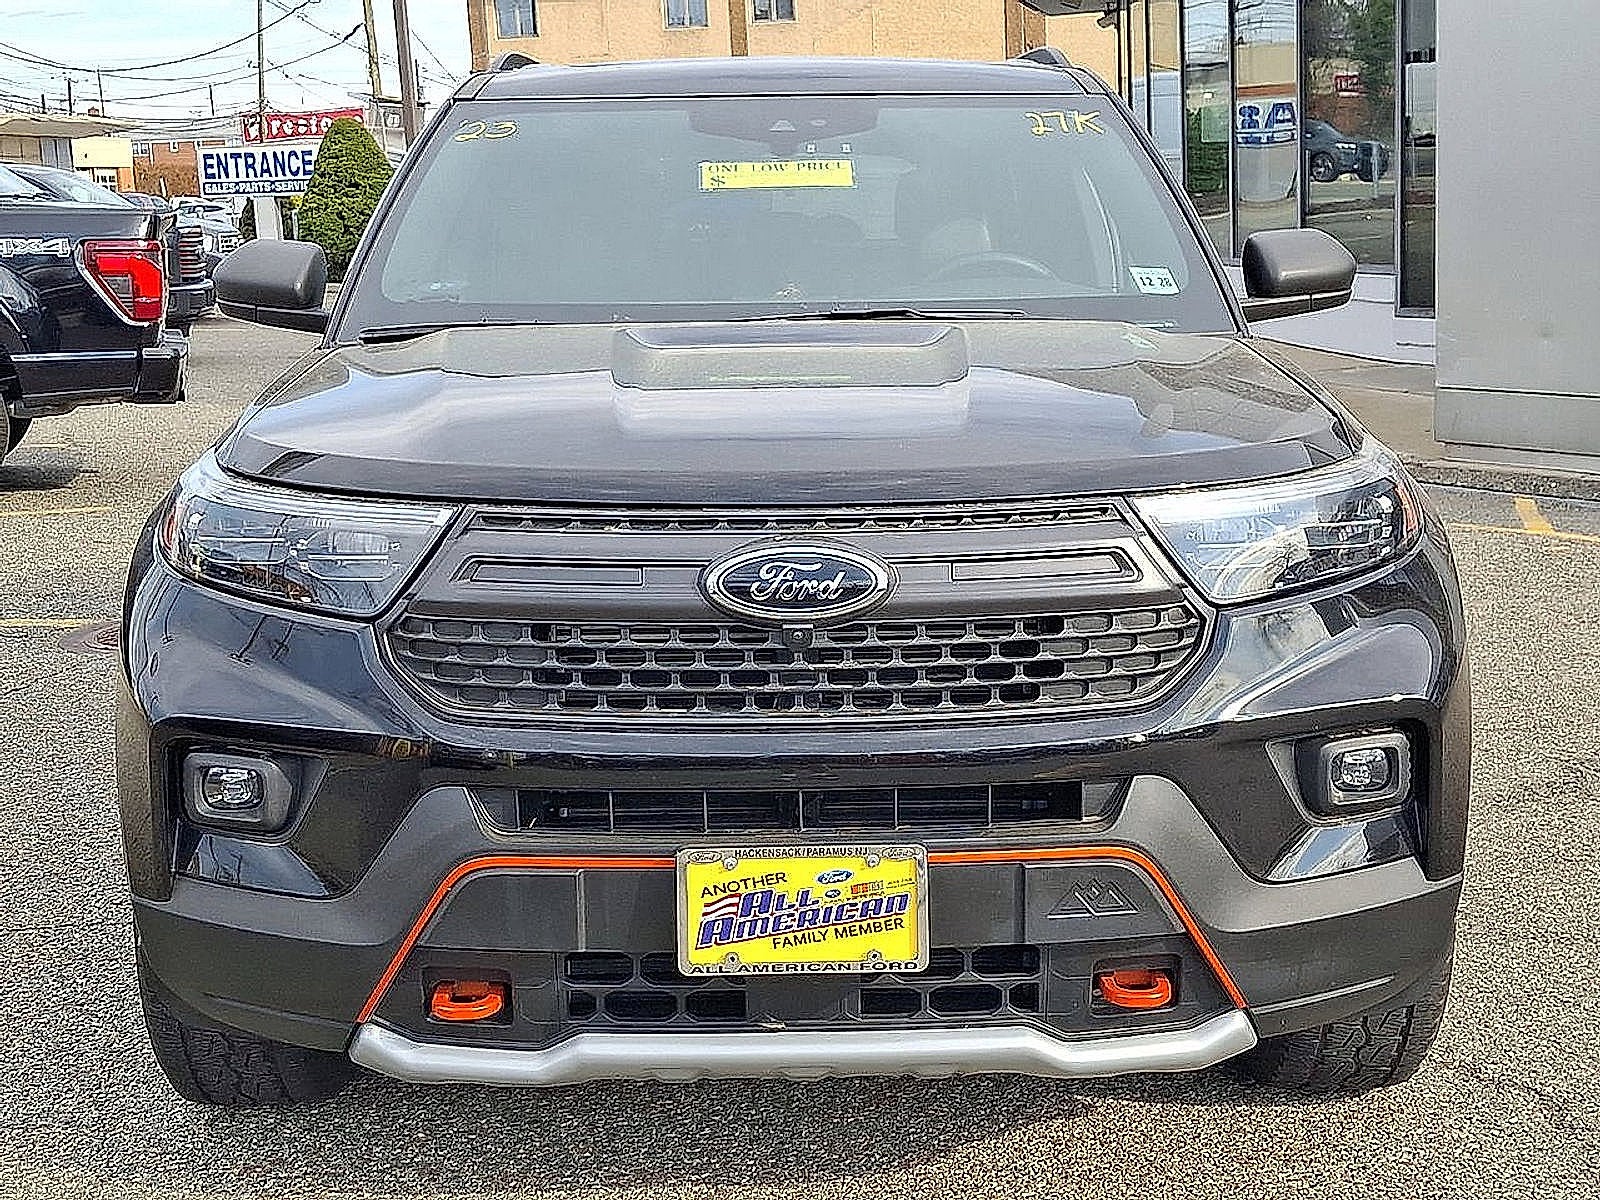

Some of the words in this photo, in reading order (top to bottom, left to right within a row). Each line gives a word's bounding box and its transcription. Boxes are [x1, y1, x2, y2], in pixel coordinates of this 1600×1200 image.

[1025, 109, 1104, 136] 27K
[203, 150, 313, 180] ENTRANCE
[752, 162, 789, 172] LOW
[1140, 276, 1155, 287] 12
[751, 560, 846, 601] Ford
[700, 871, 787, 899] ANOTHER
[820, 870, 850, 884] Ford
[772, 928, 829, 950] FAMILY
[834, 917, 905, 940] MEMBER
[690, 964, 731, 974] ALL
[736, 963, 852, 973] AMERICAN
[859, 961, 918, 972] FORD
